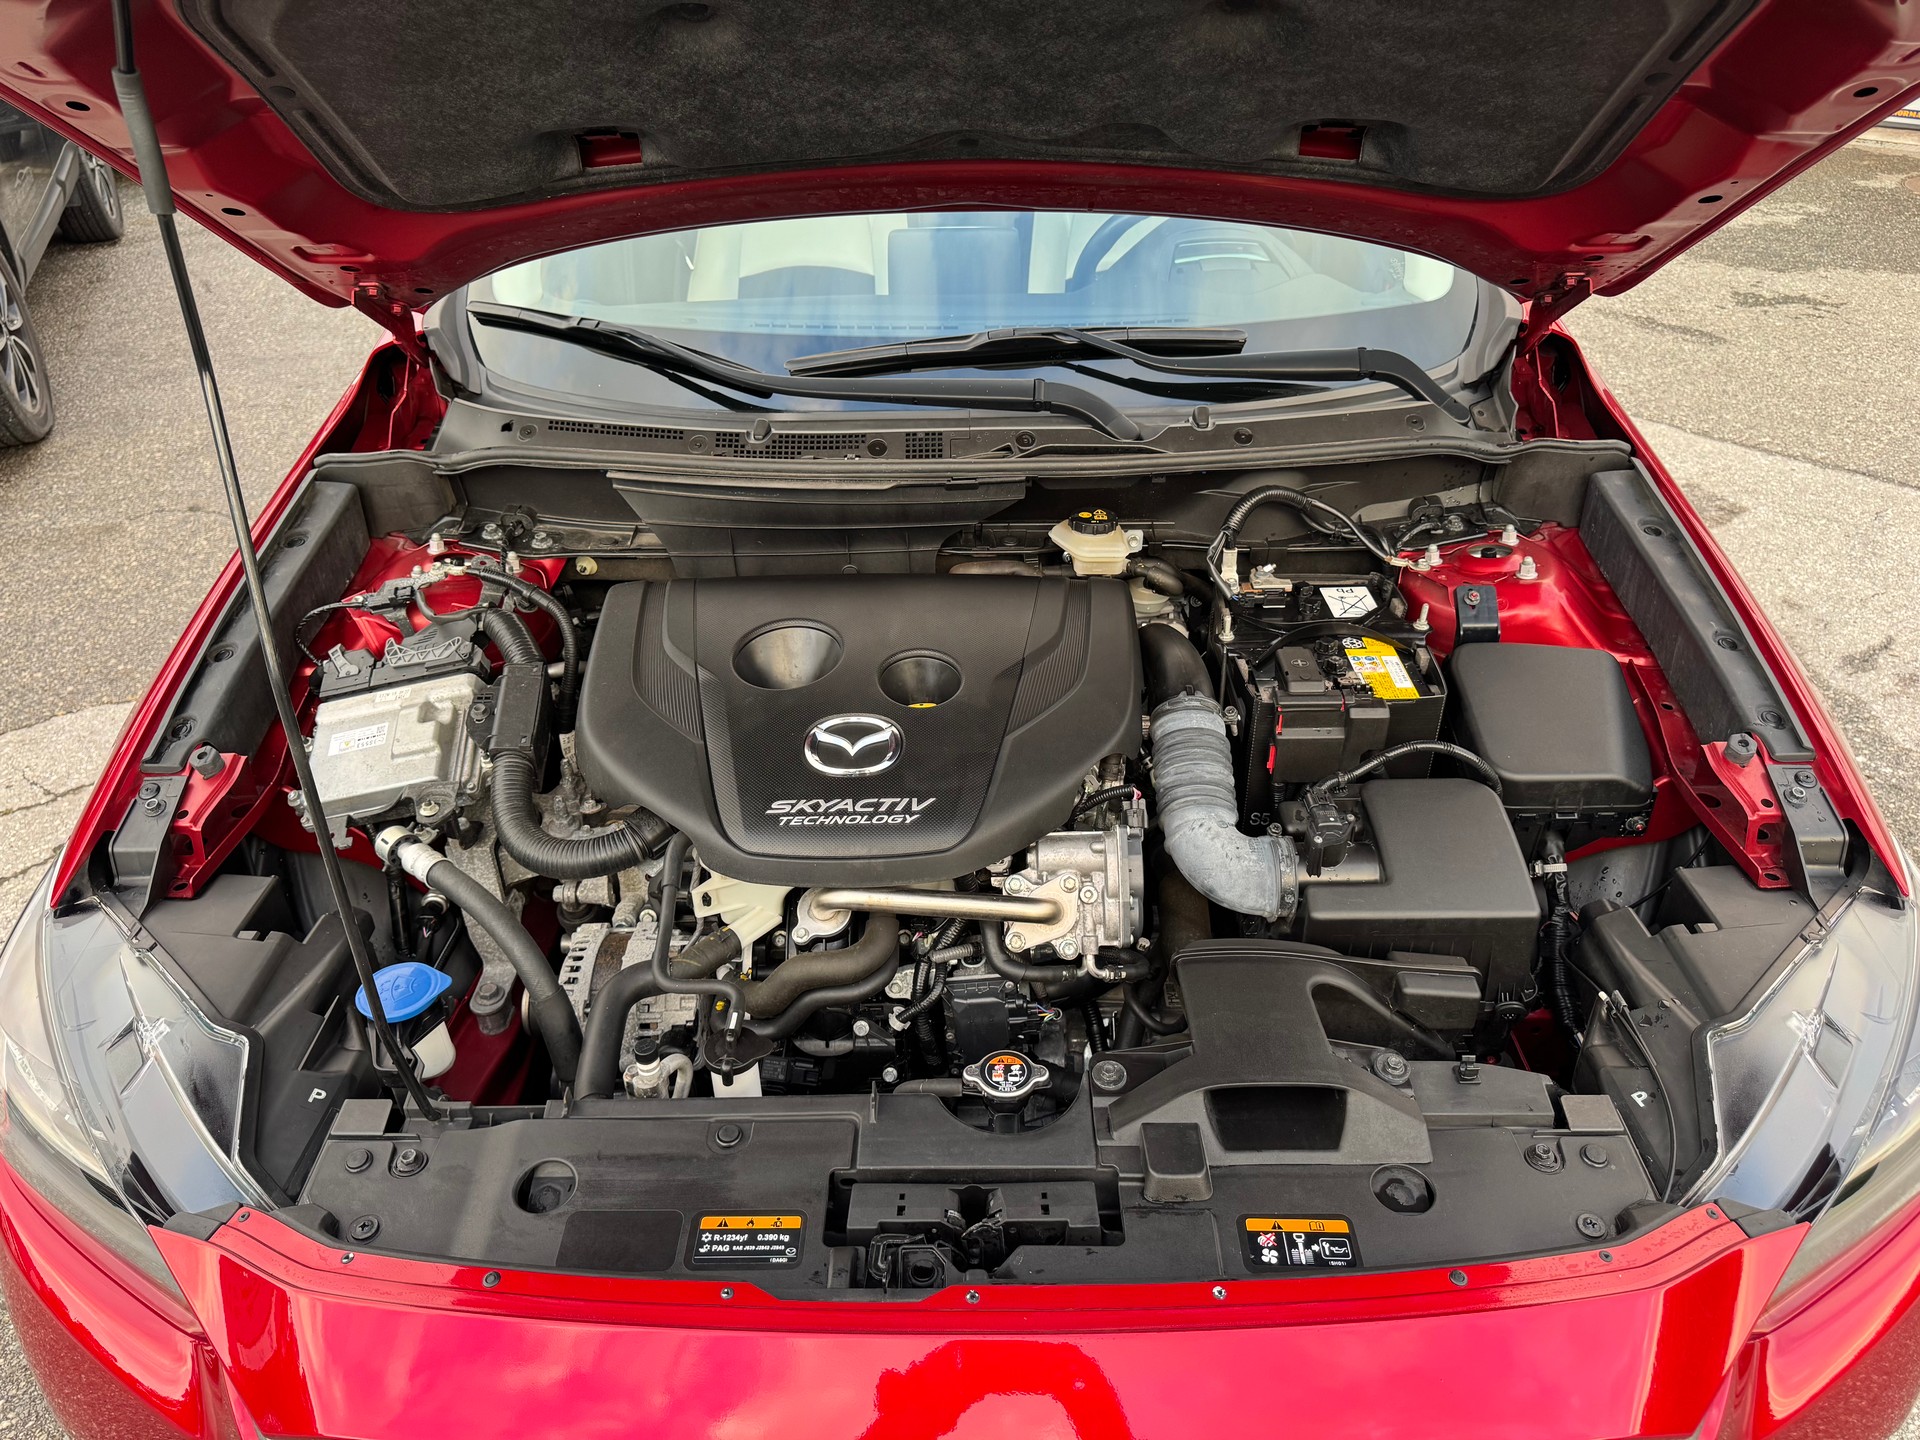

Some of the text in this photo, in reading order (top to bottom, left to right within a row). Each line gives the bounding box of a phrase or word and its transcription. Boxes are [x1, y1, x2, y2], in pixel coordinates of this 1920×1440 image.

[765, 797, 936, 815] SKYACTIV
[778, 814, 920, 826] TECHNOLOGY
[1249, 812, 1271, 826] S5
[307, 1087, 327, 1103] P
[1630, 1090, 1648, 1108] P
[713, 1233, 790, 1242] R-1234yf 0.390 kg
